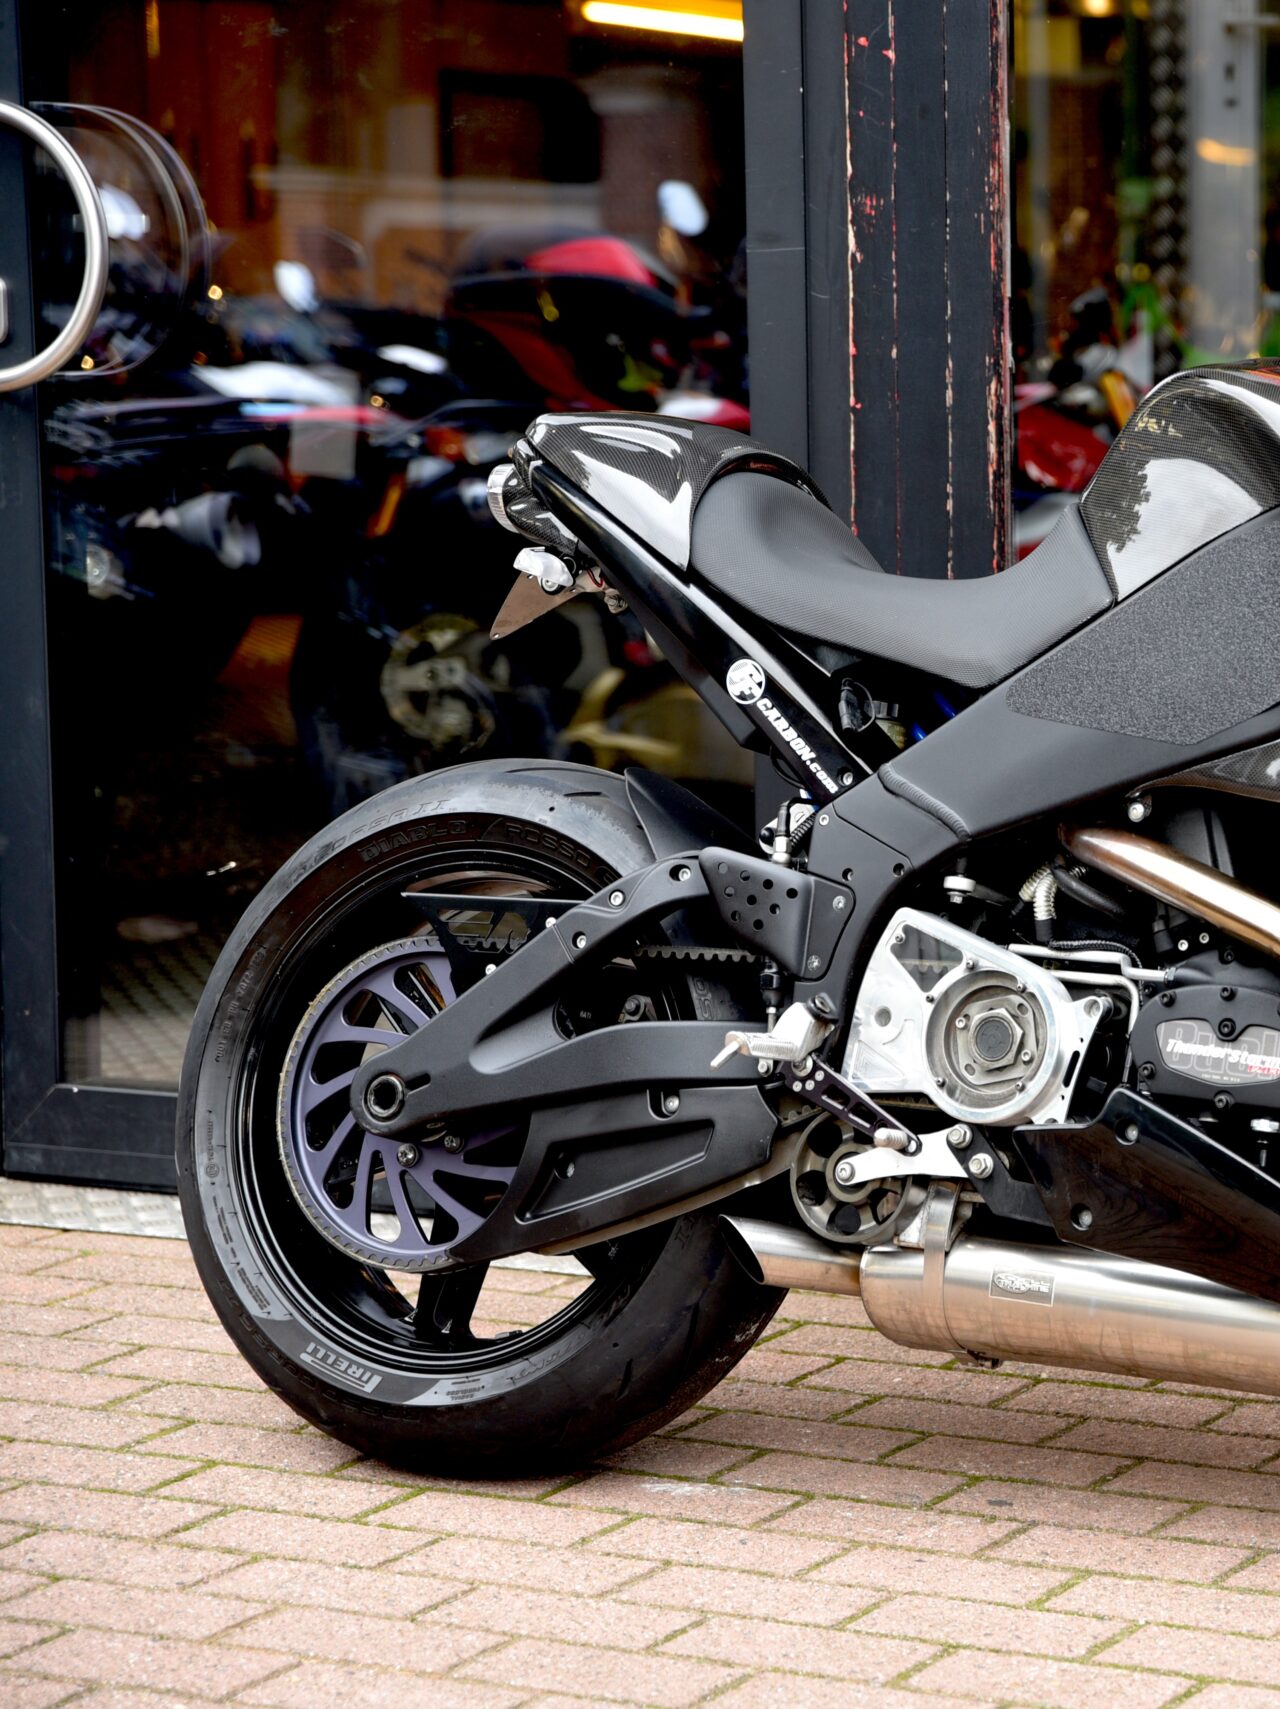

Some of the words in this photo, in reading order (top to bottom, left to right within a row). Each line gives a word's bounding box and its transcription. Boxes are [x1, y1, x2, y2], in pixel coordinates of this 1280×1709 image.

[756, 697, 839, 794] CARBON.com
[358, 819, 468, 862] DIABLO
[300, 1341, 383, 1394] PIRELLI
